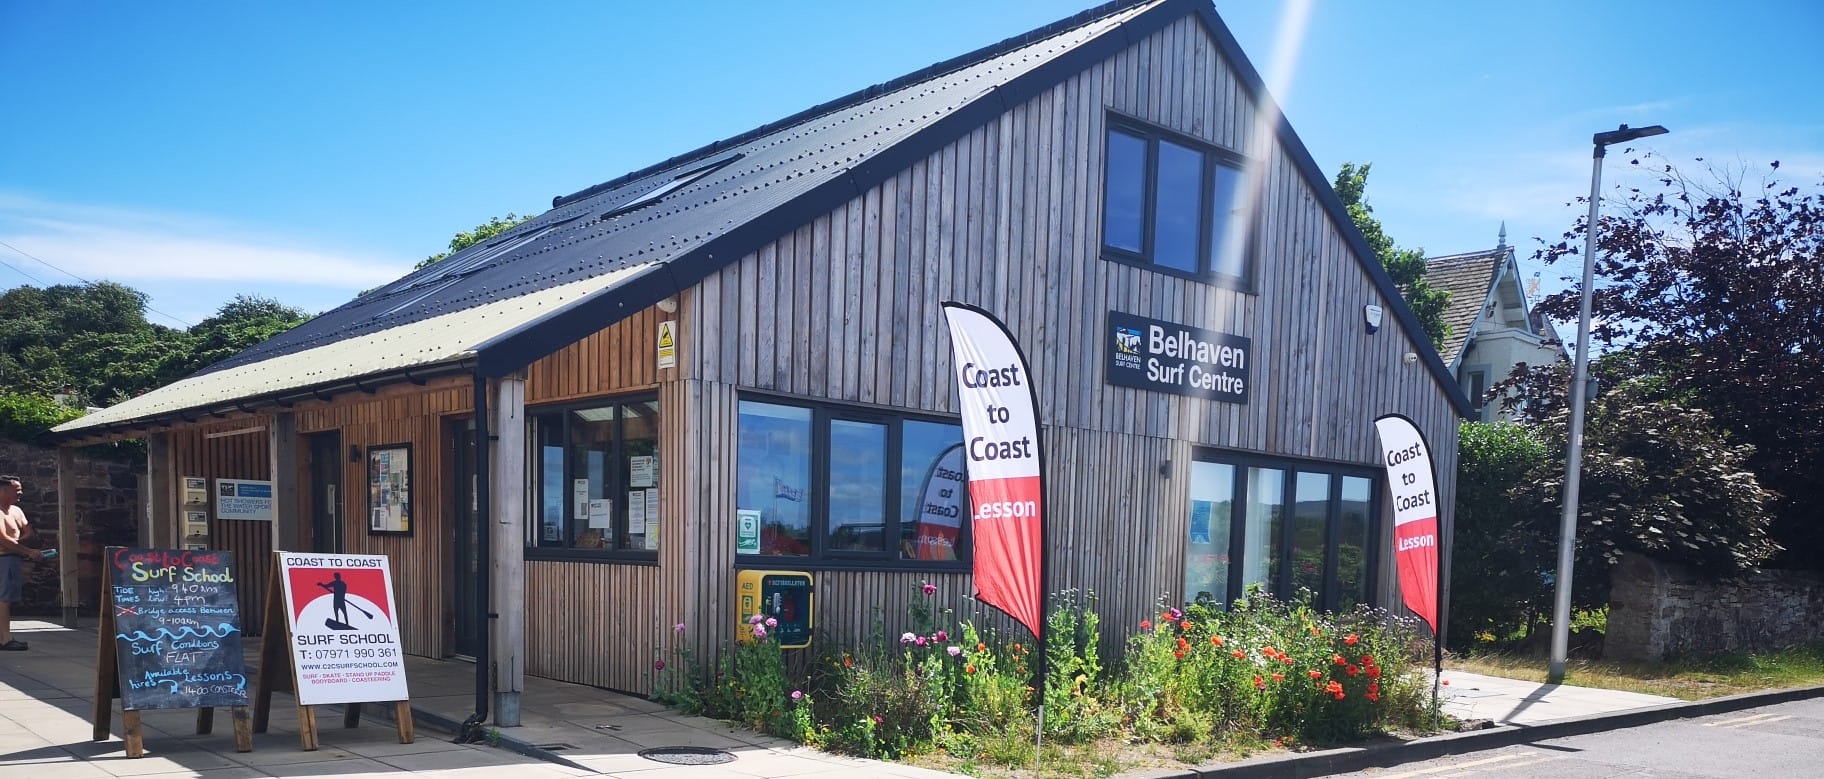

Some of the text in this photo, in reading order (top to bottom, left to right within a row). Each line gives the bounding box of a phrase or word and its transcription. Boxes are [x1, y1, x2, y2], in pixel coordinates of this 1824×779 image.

[1149, 324, 1244, 369] Belhaven
[1115, 352, 1141, 363] BELHAVEN
[962, 362, 1020, 389] Coast
[1147, 357, 1244, 395] Surf Centre
[987, 404, 1010, 424] to
[970, 436, 1031, 461] Coast
[1387, 442, 1421, 467] Coast
[1402, 472, 1416, 486] to
[1397, 490, 1430, 512] Coast
[1399, 534, 1434, 552] Lesson
[162, 551, 180, 568] to
[287, 557, 383, 568] COAST TO COAST
[131, 562, 234, 582] Surf School
[174, 595, 206, 606] 4pm
[138, 607, 165, 618] Bridge
[297, 633, 394, 645] SURF SCHOOL
[131, 640, 219, 655] Surf Conditions
[299, 648, 397, 660] T: 07971 990 361
[166, 651, 203, 663] FLAT
[301, 661, 398, 670] WWW.C2CSURFSCHOOL.COM
[144, 668, 190, 680] Available
[185, 671, 233, 682] Lessons
[129, 680, 157, 690] hires
